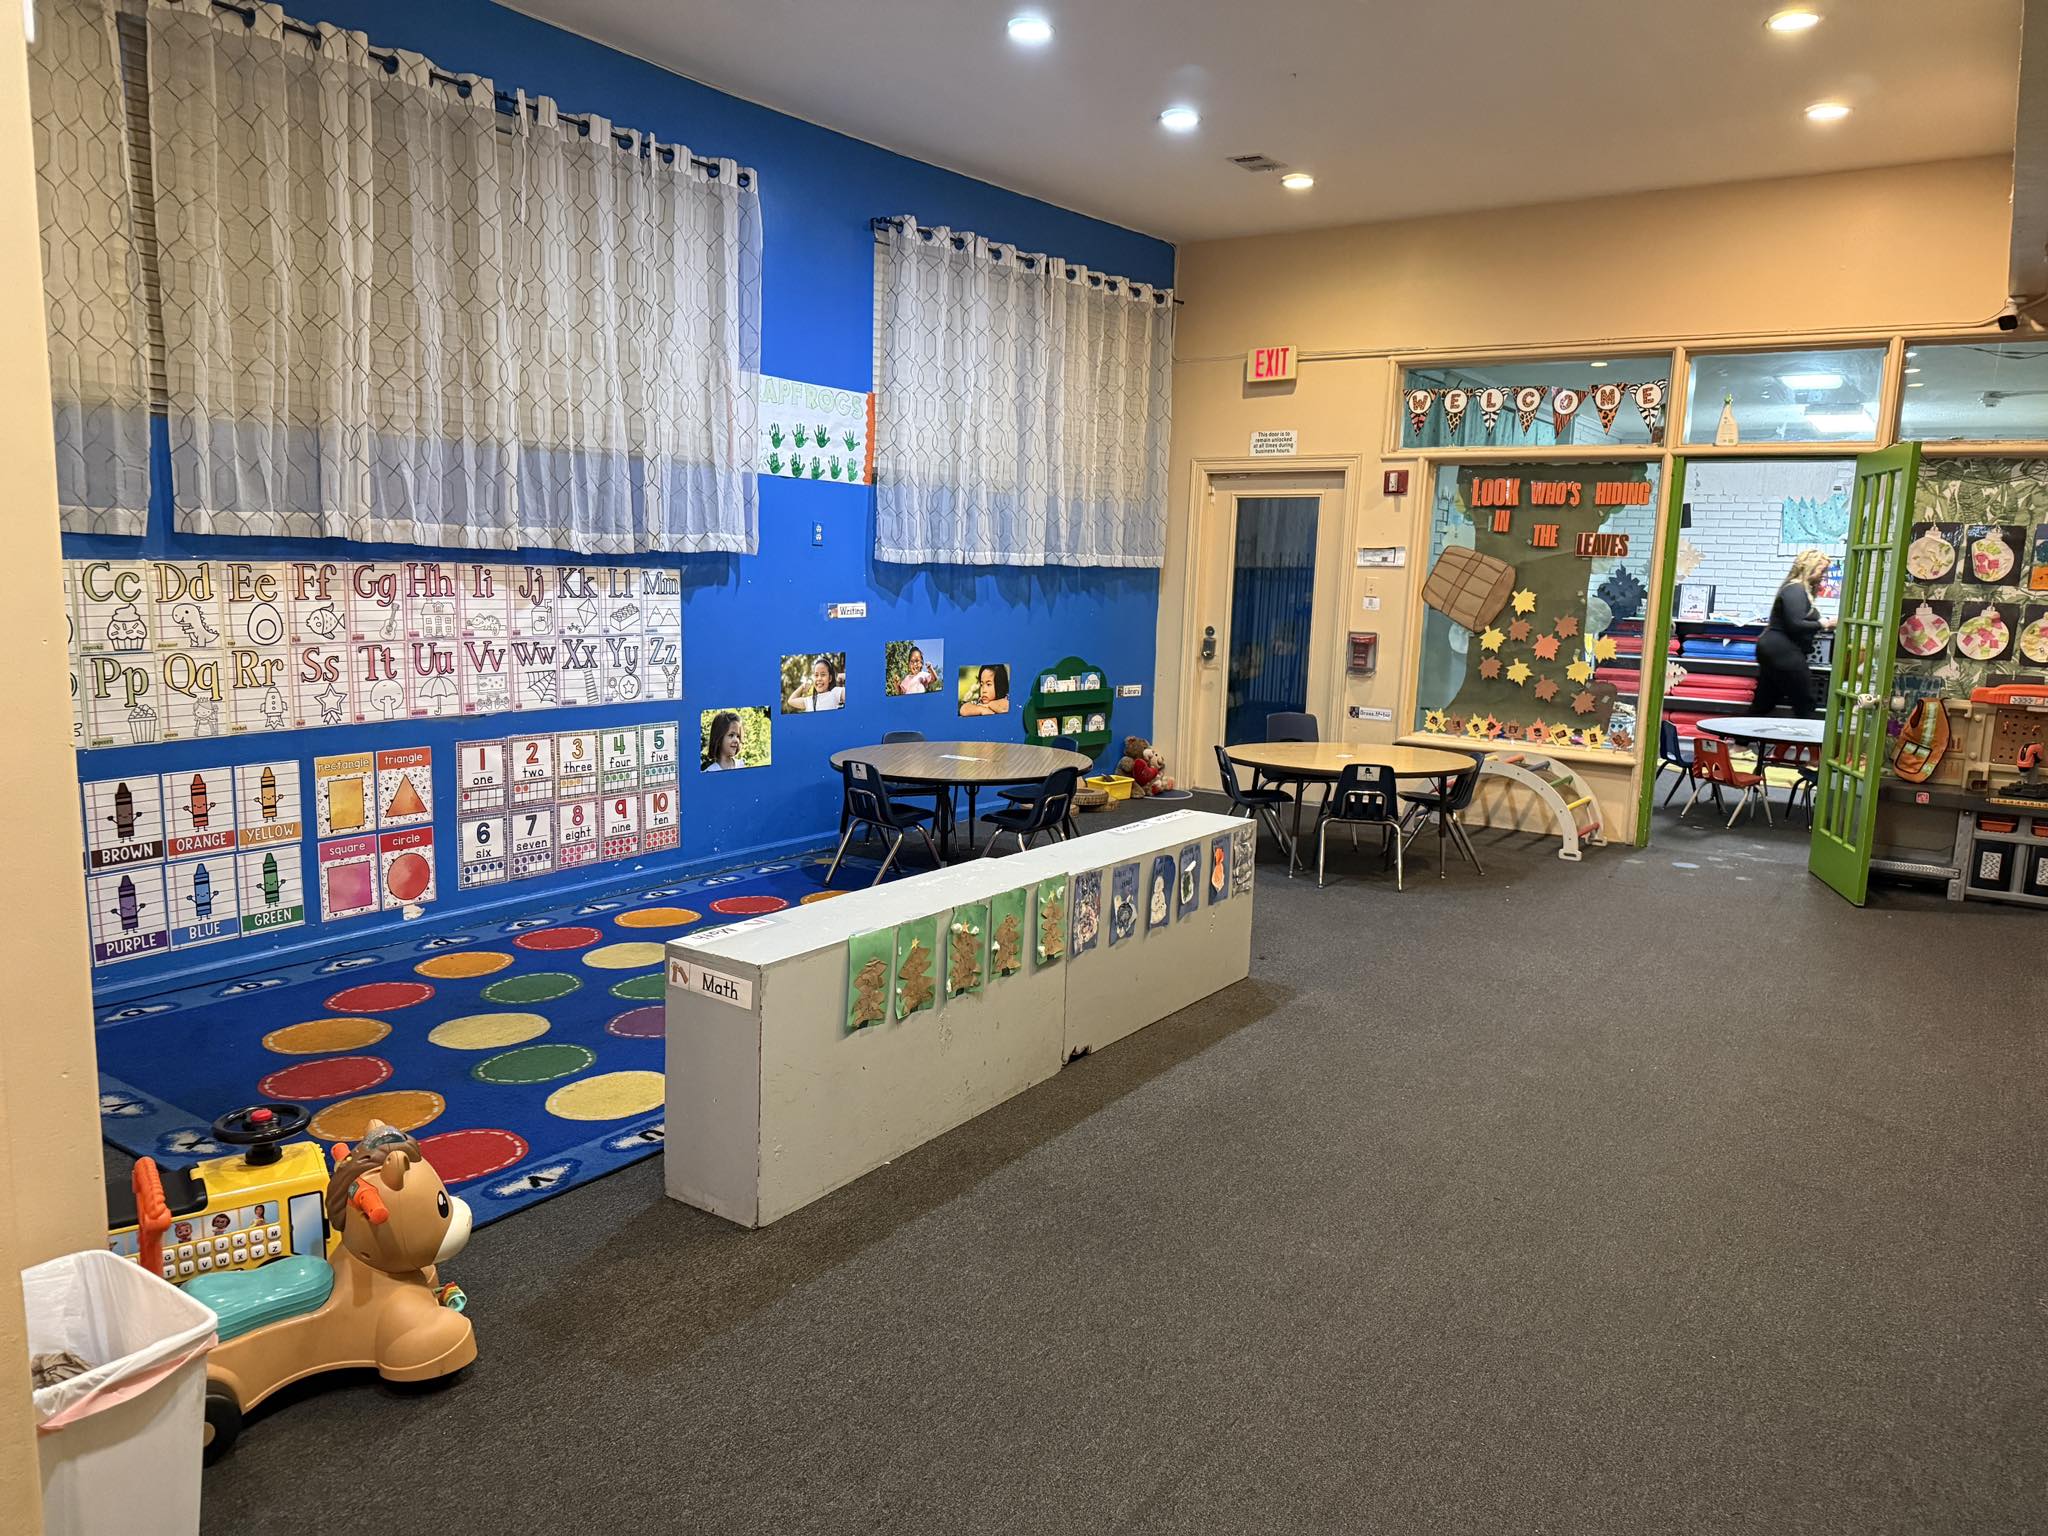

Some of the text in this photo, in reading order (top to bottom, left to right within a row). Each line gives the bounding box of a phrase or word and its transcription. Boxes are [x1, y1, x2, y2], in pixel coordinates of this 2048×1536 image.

[1255, 348, 1289, 378] EXIT
[1412, 386, 1655, 412] WELCOME
[1471, 477, 1650, 507] LOOK WHO'S HIDING
[1493, 509, 1629, 557] IN THE LEAVES
[82, 562, 142, 602] Cc
[153, 562, 214, 603] Dd
[228, 563, 278, 602] Ee
[293, 563, 337, 600] Ff
[353, 564, 397, 606] Gg
[406, 563, 454, 598] Hh
[472, 565, 494, 598] Ii
[519, 567, 545, 605] Jj
[557, 567, 598, 598] Kk
[643, 571, 680, 595] Mm
[840, 607, 864, 617] Writing
[412, 642, 454, 676] Uu
[464, 641, 506, 672] Vv
[511, 642, 556, 666] Ww
[562, 639, 598, 669] Xx
[606, 638, 639, 675] Yy
[649, 637, 677, 665] Zz
[232, 650, 284, 688] Rr
[301, 647, 340, 683] Ss
[358, 644, 398, 681] Tt
[91, 657, 149, 707] Pp
[163, 653, 223, 701] Qq
[571, 738, 584, 760] 3
[614, 734, 626, 755] 4
[654, 730, 665, 750] 5
[385, 753, 423, 765] triangle
[526, 742, 539, 764] 2
[609, 757, 631, 768] four
[651, 752, 669, 762] five
[318, 758, 370, 772] rectangle
[522, 767, 544, 779] two
[564, 761, 593, 773] three
[472, 775, 493, 786] one
[614, 799, 627, 819] 9
[653, 792, 668, 813] 10
[525, 814, 537, 836] 7
[572, 805, 584, 826] 8
[653, 816, 669, 826] ten
[246, 824, 294, 841] YELLOW
[476, 822, 491, 844] 6
[565, 828, 592, 841] eight
[612, 823, 631, 834] nine
[176, 832, 227, 851] ORANGE
[329, 842, 366, 856] square
[392, 834, 421, 846] circle
[516, 839, 548, 851] seven
[102, 842, 153, 863] BROWN
[476, 849, 491, 859] six
[254, 909, 292, 926] GREEN
[189, 922, 221, 939] BLUE
[106, 933, 158, 956] PURPLE
[702, 972, 739, 1001] Math
